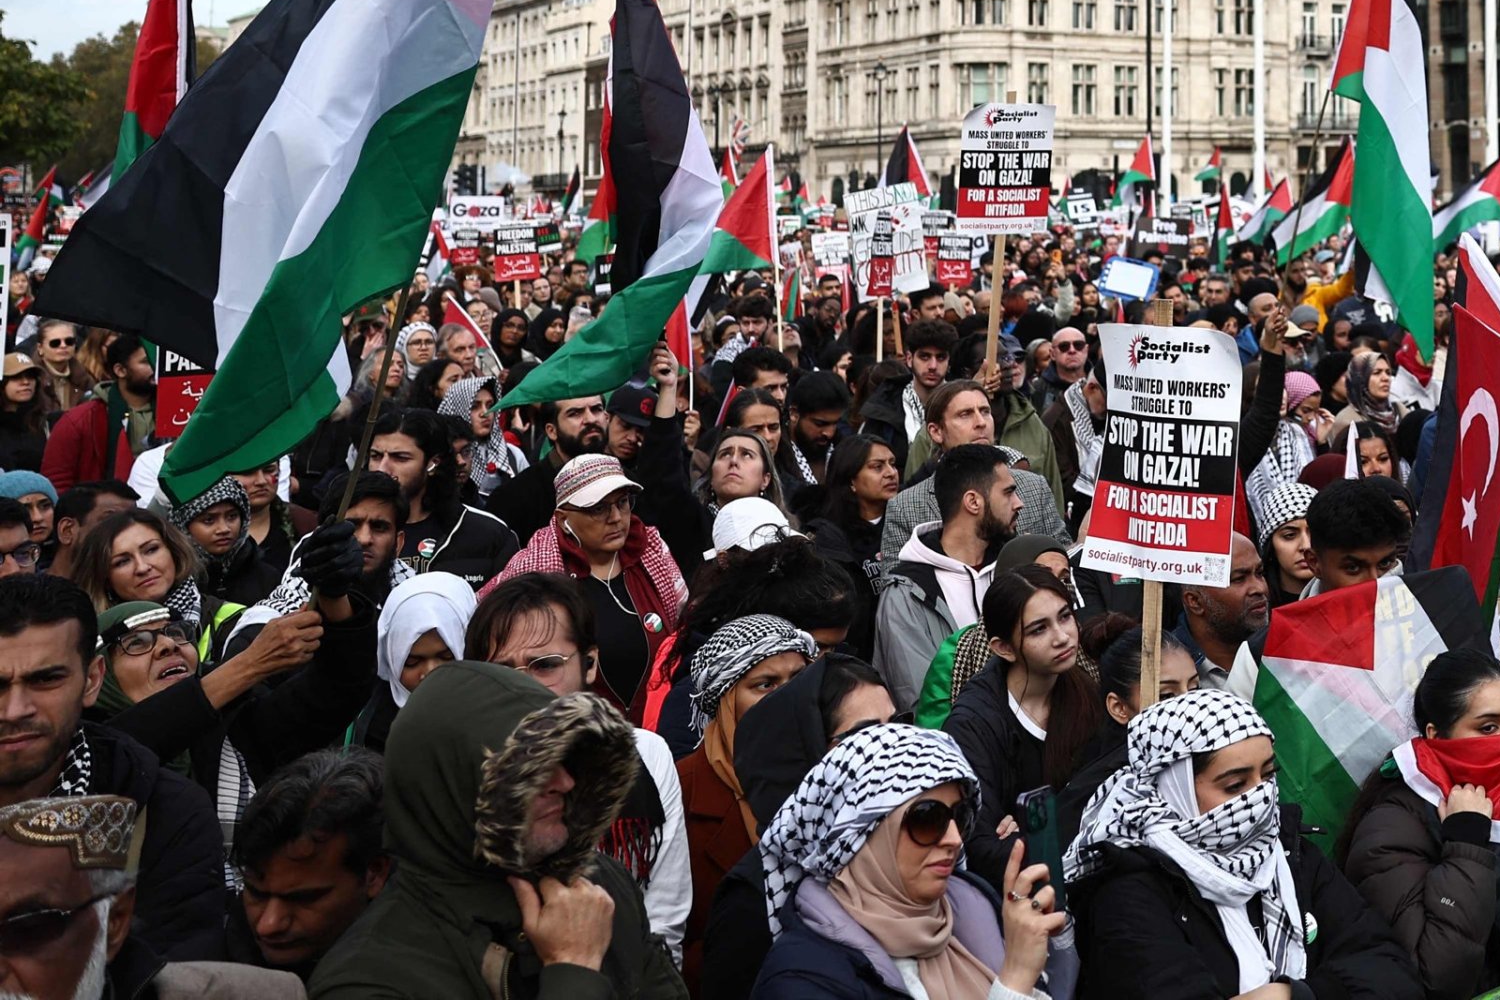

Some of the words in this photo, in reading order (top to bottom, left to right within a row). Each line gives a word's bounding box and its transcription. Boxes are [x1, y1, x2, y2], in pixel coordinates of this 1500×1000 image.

[997, 109, 1038, 117] Socialist
[968, 131, 988, 139] MASS
[990, 131, 1013, 139] UNITED
[986, 141, 1019, 149] STRUGGLE
[1021, 140, 1029, 149] TO
[963, 152, 994, 169] STOP
[998, 153, 1019, 169] THE
[1022, 152, 1049, 169] WAR
[978, 169, 995, 185] ON
[999, 169, 1032, 185] GAZA!
[967, 188, 985, 202] FOR
[987, 188, 994, 202] A
[996, 188, 1041, 202] SOCIALIST
[453, 203, 500, 217] Gza
[985, 203, 1025, 217] INTIFADA
[960, 221, 1032, 231] socialistparty.org.uk
[1152, 219, 1177, 232] Free
[497, 228, 534, 240] FREEDOM
[1138, 230, 1188, 245] Palestine
[496, 241, 537, 255] PALESTINE
[1140, 336, 1211, 354] Socialist
[1114, 374, 1133, 392] MASS
[1134, 377, 1163, 395] UNITED
[1131, 395, 1174, 415] STRUGGLE
[1179, 400, 1192, 416] TO
[1108, 415, 1138, 448] STOP
[1141, 420, 1175, 453] THE
[1181, 424, 1234, 457] WAR
[1124, 450, 1139, 482] ON
[1142, 454, 1200, 488] GAZA!
[1106, 484, 1130, 512] FOR
[1131, 489, 1138, 514] A
[1139, 492, 1218, 521] SOCIALIST
[1128, 517, 1187, 547] INTIFADA
[1088, 549, 1203, 575] socialistparty.org.uk
